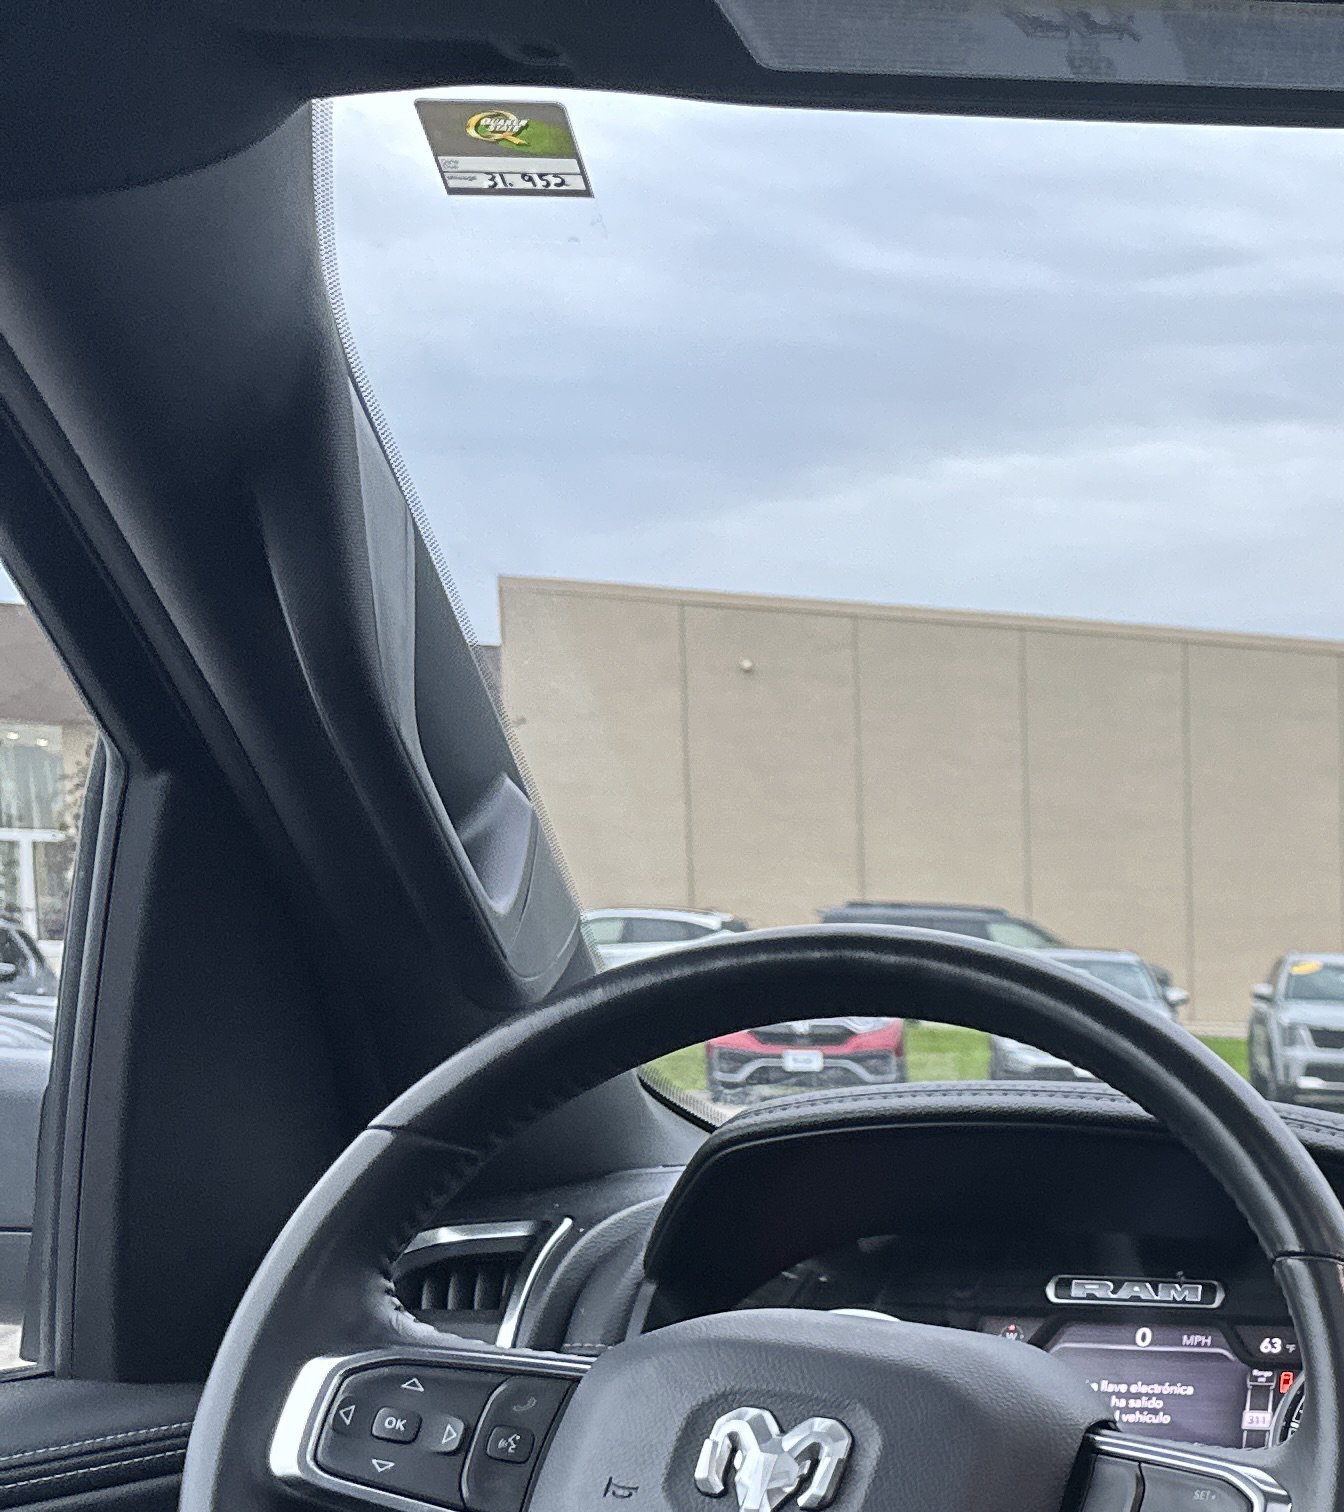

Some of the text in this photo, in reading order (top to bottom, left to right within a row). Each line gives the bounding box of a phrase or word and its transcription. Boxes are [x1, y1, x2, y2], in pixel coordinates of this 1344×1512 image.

[1070, 1280, 1203, 1303] RAM
[1135, 1327, 1212, 1347] 0 MPH
[1260, 1337, 1283, 1353] 63
[1101, 1380, 1127, 1394] llave
[1130, 1380, 1195, 1395] electrónica
[1111, 1395, 1164, 1409] ha salido
[384, 1416, 406, 1432] OK
[1122, 1410, 1171, 1424] vehículo
